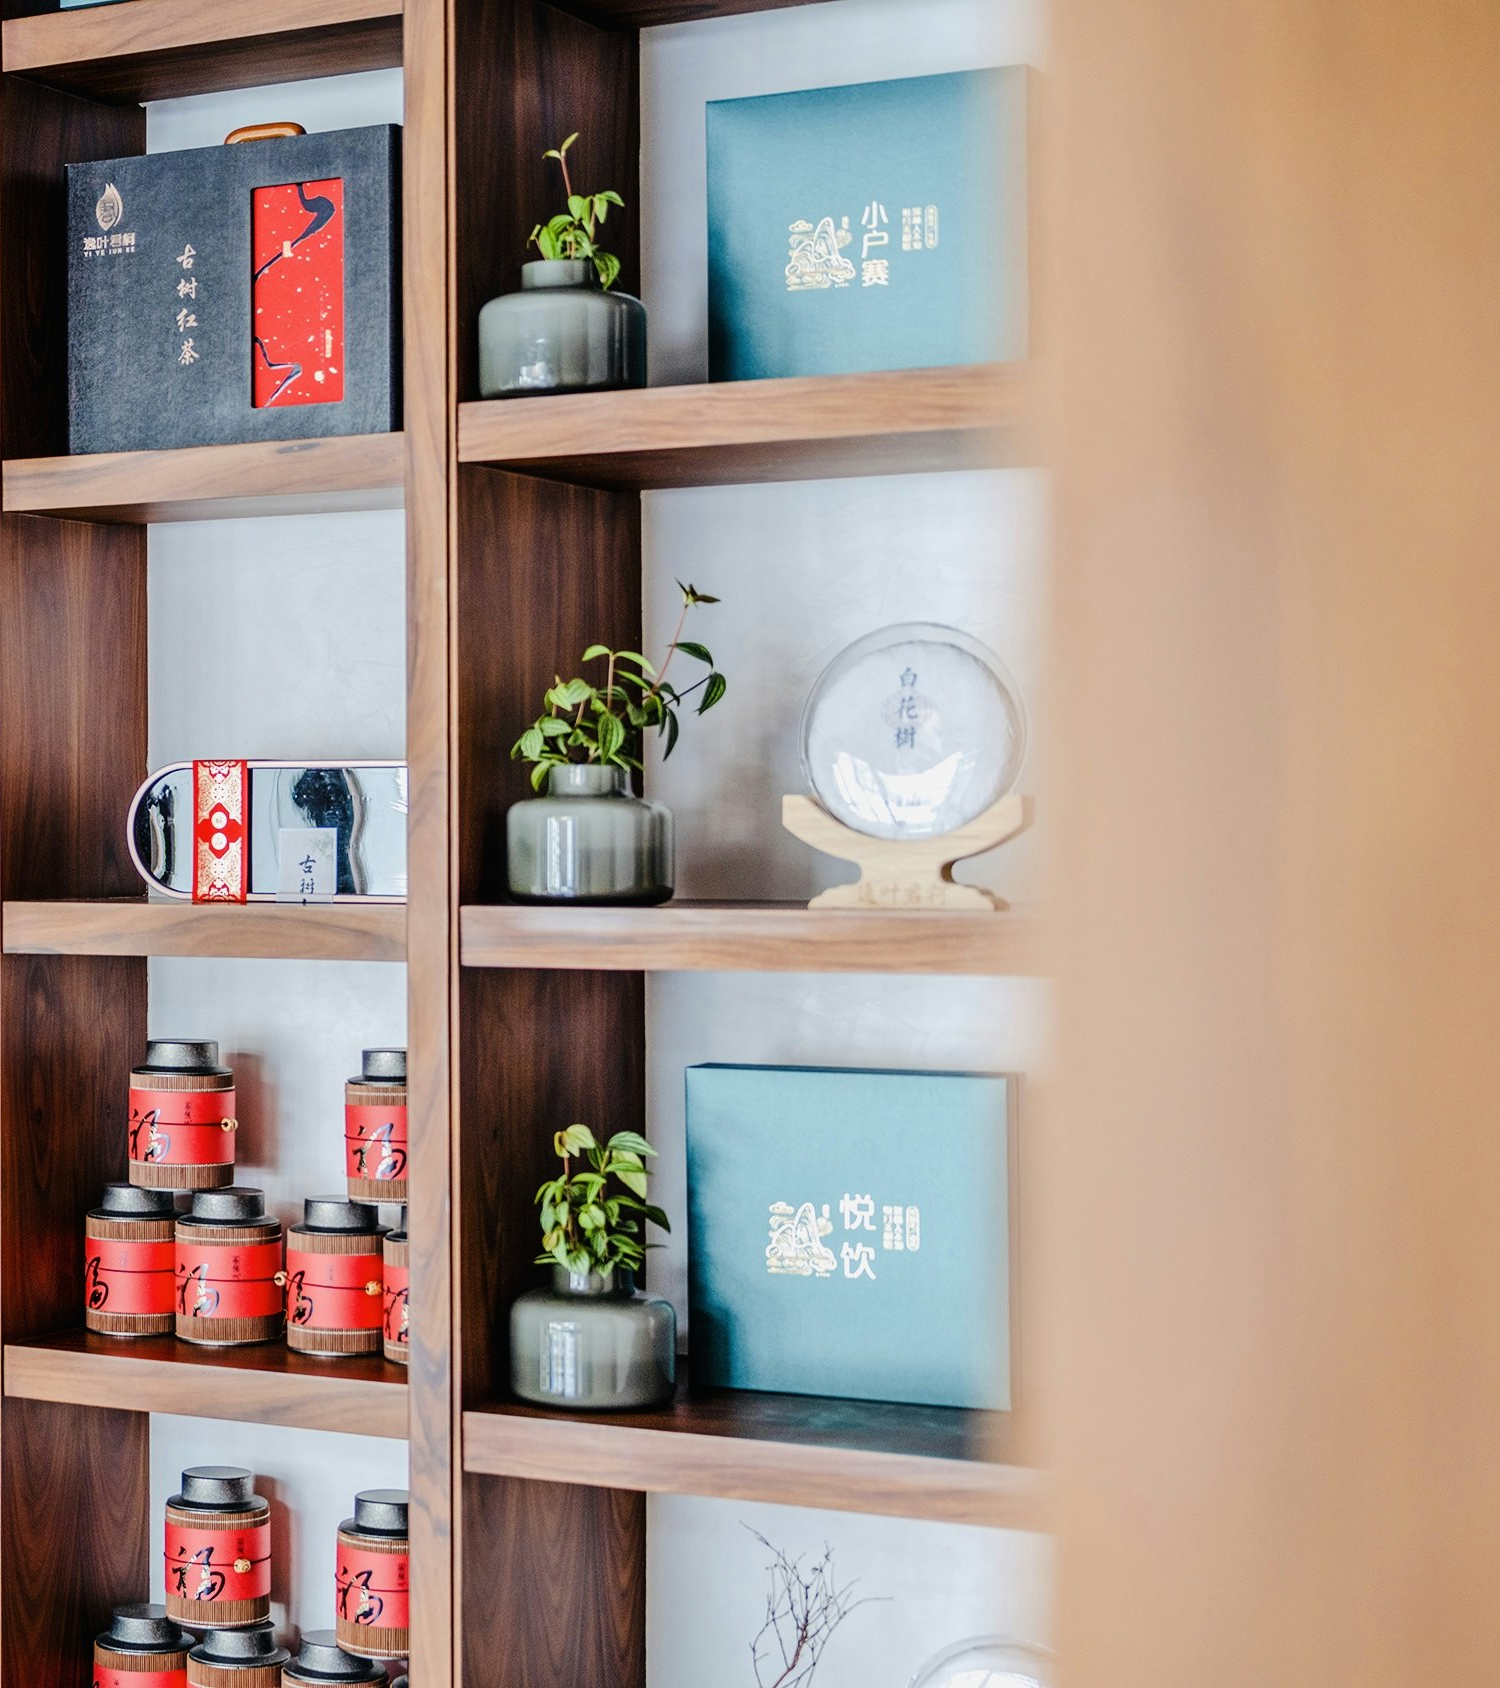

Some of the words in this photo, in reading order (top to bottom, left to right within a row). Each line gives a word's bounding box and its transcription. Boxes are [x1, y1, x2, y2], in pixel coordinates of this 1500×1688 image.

[861, 200, 889, 287] 小户赛
[176, 244, 199, 365] 古树红茶
[839, 1193, 877, 1280] 悦饮
